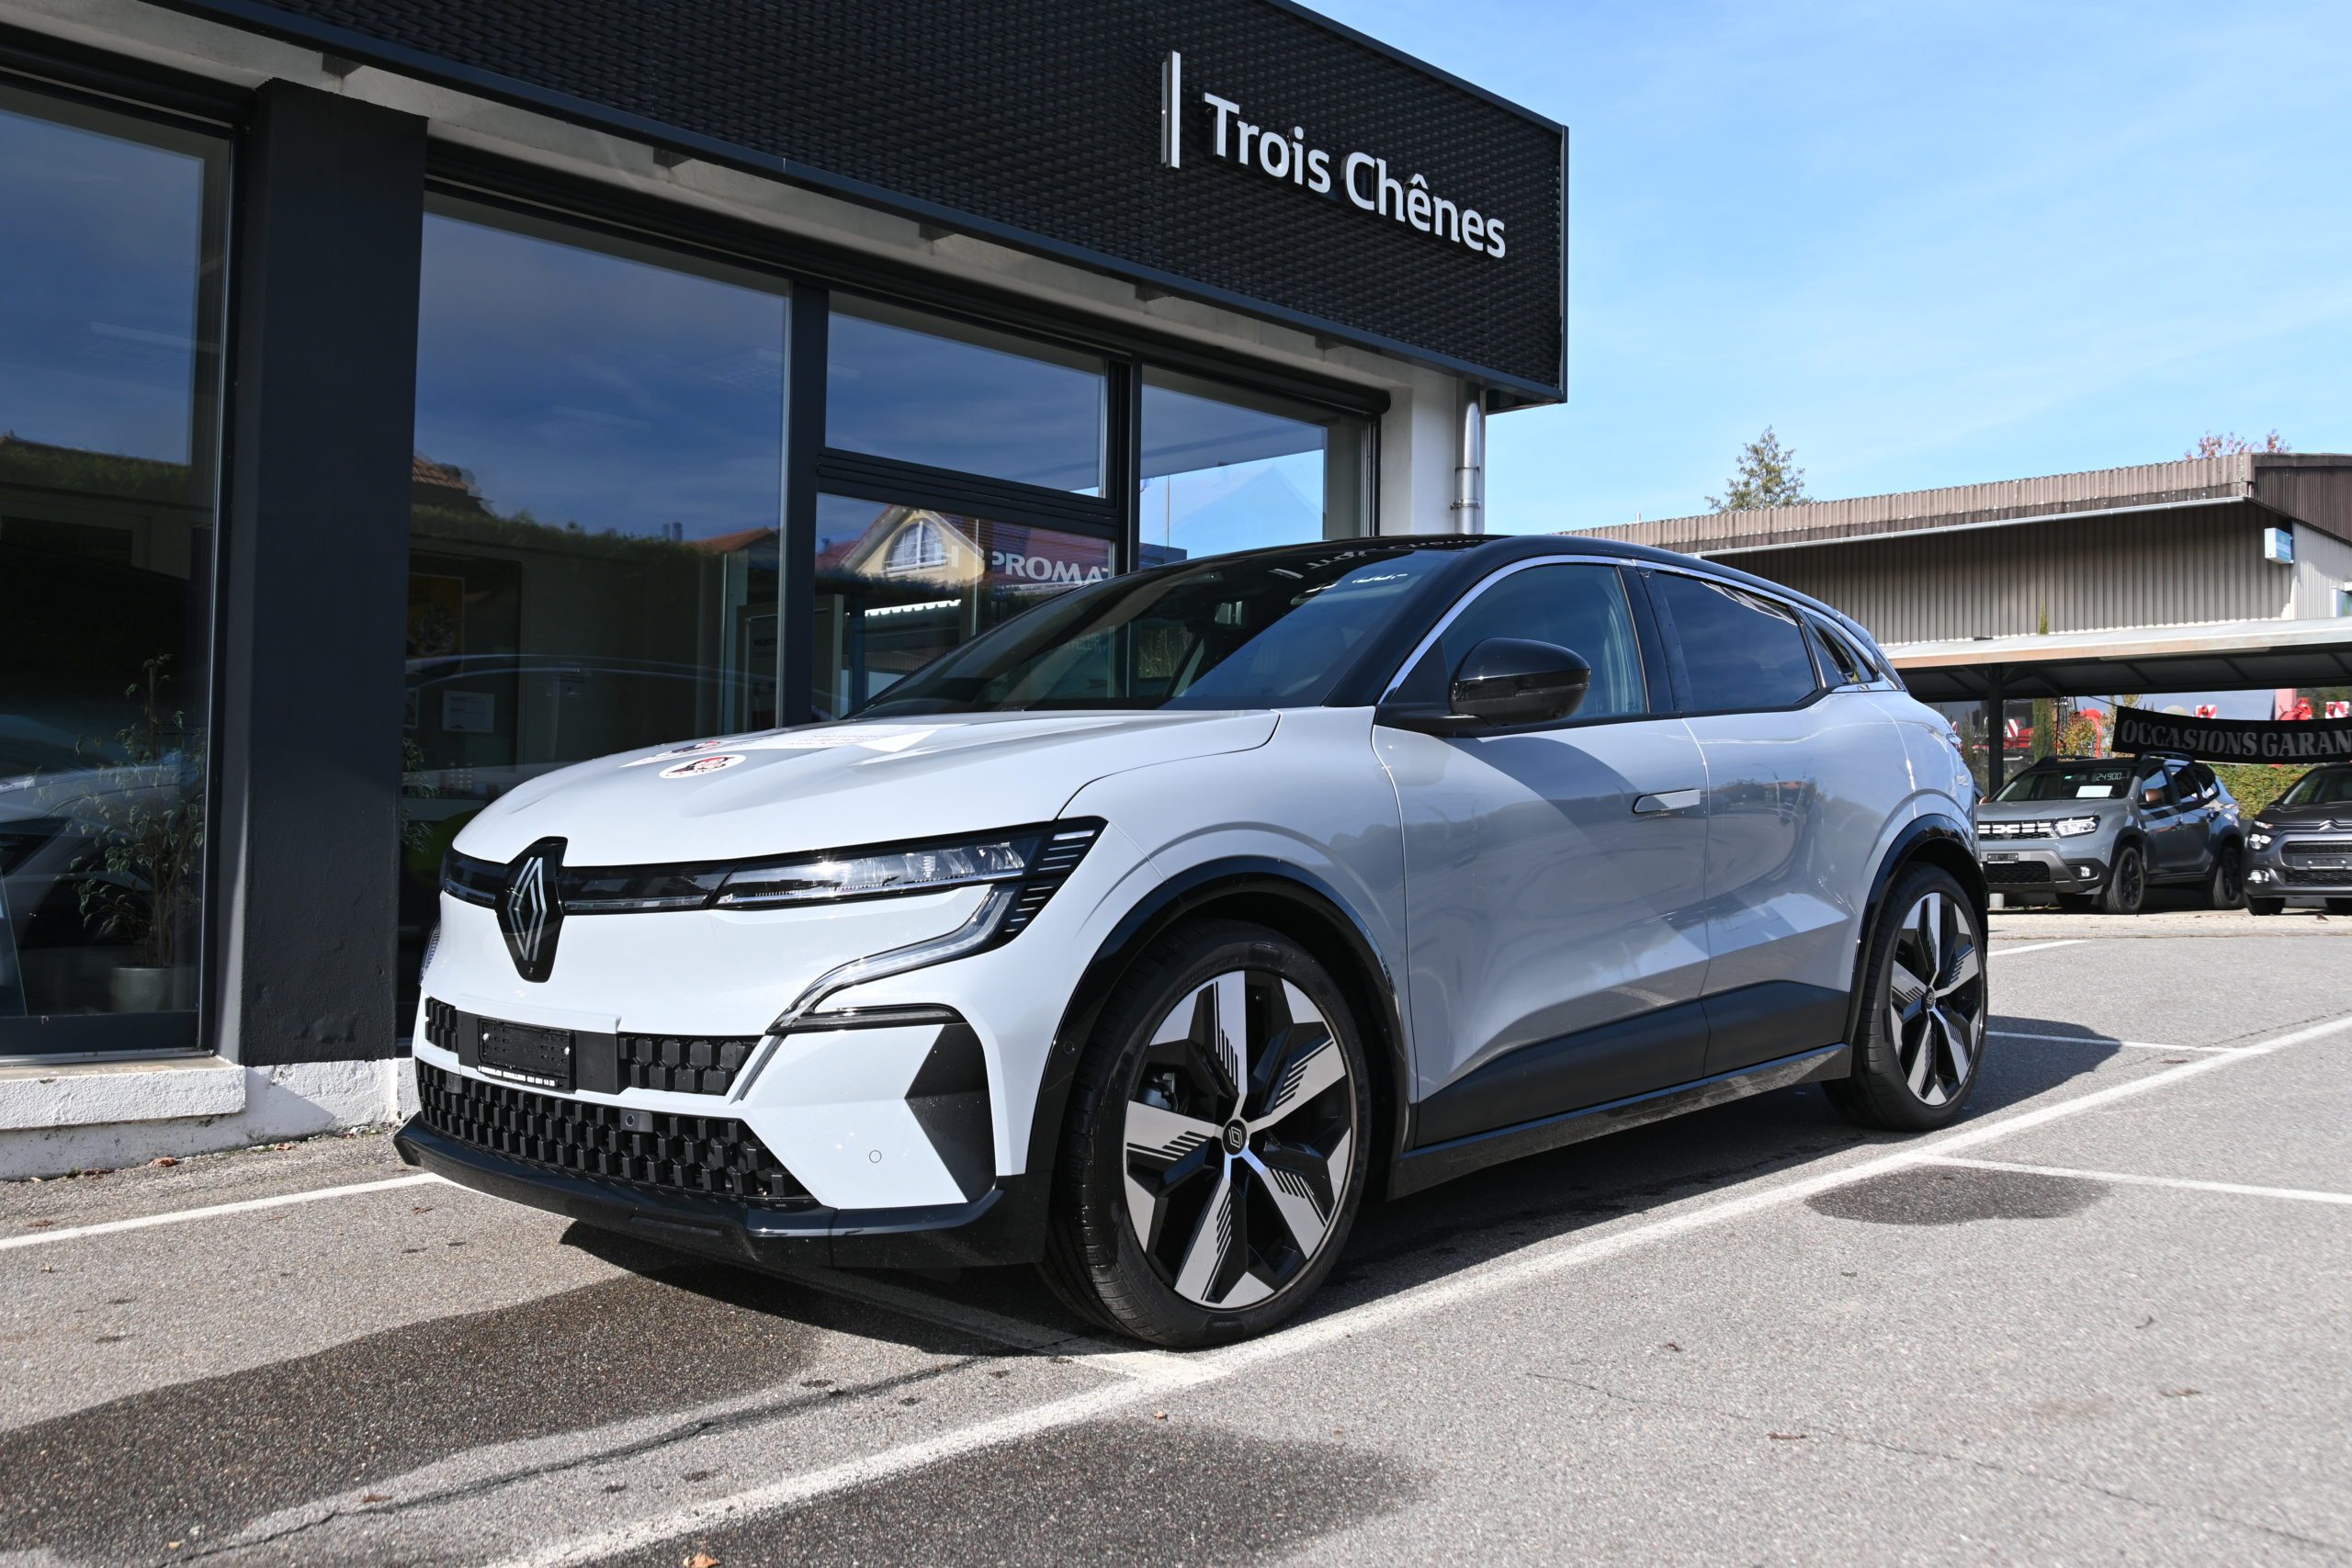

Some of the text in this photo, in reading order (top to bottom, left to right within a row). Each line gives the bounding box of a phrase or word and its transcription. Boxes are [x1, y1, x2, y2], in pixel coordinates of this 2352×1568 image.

[1204, 91, 1507, 259] Trois Chênes
[991, 550, 1110, 585] PROMA
[2120, 718, 2257, 758] OCCASIONS
